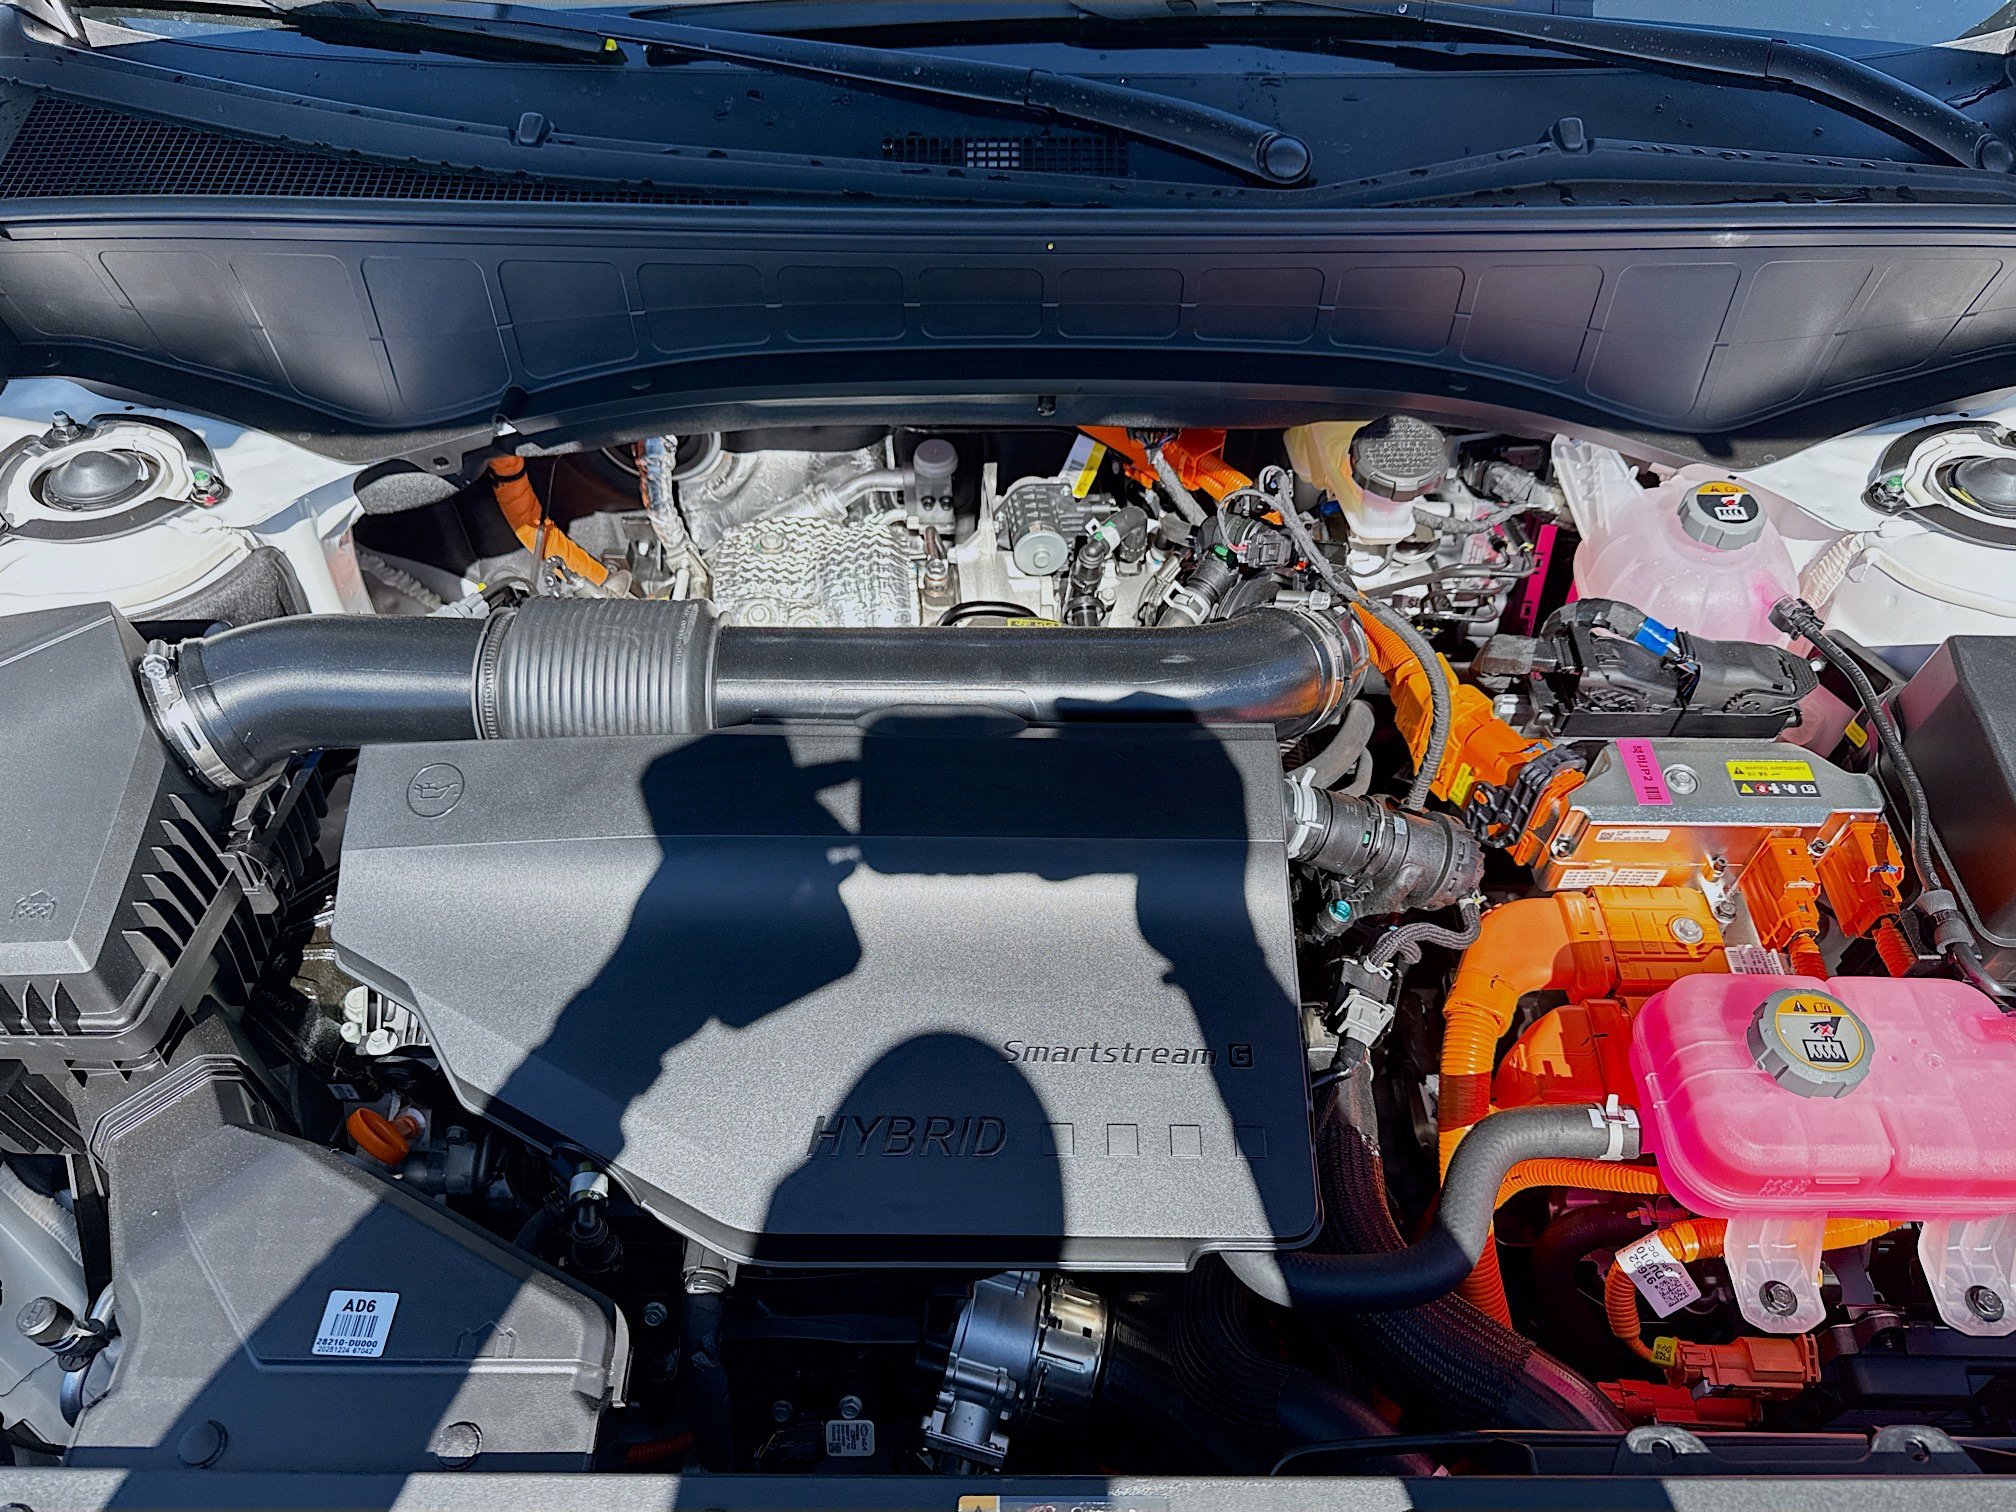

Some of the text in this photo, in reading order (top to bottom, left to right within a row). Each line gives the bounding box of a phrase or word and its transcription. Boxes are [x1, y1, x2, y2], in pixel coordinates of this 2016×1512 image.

[1003, 1040, 1219, 1066] Smartstream
[807, 1115, 1007, 1158] HYBRID
[1629, 1254, 1657, 1285] 91662
[1637, 1246, 1665, 1280] DU010
[342, 1298, 377, 1313] AD6
[316, 1338, 378, 1348] 28210-DU000
[352, 1347, 374, 1355] 67042
